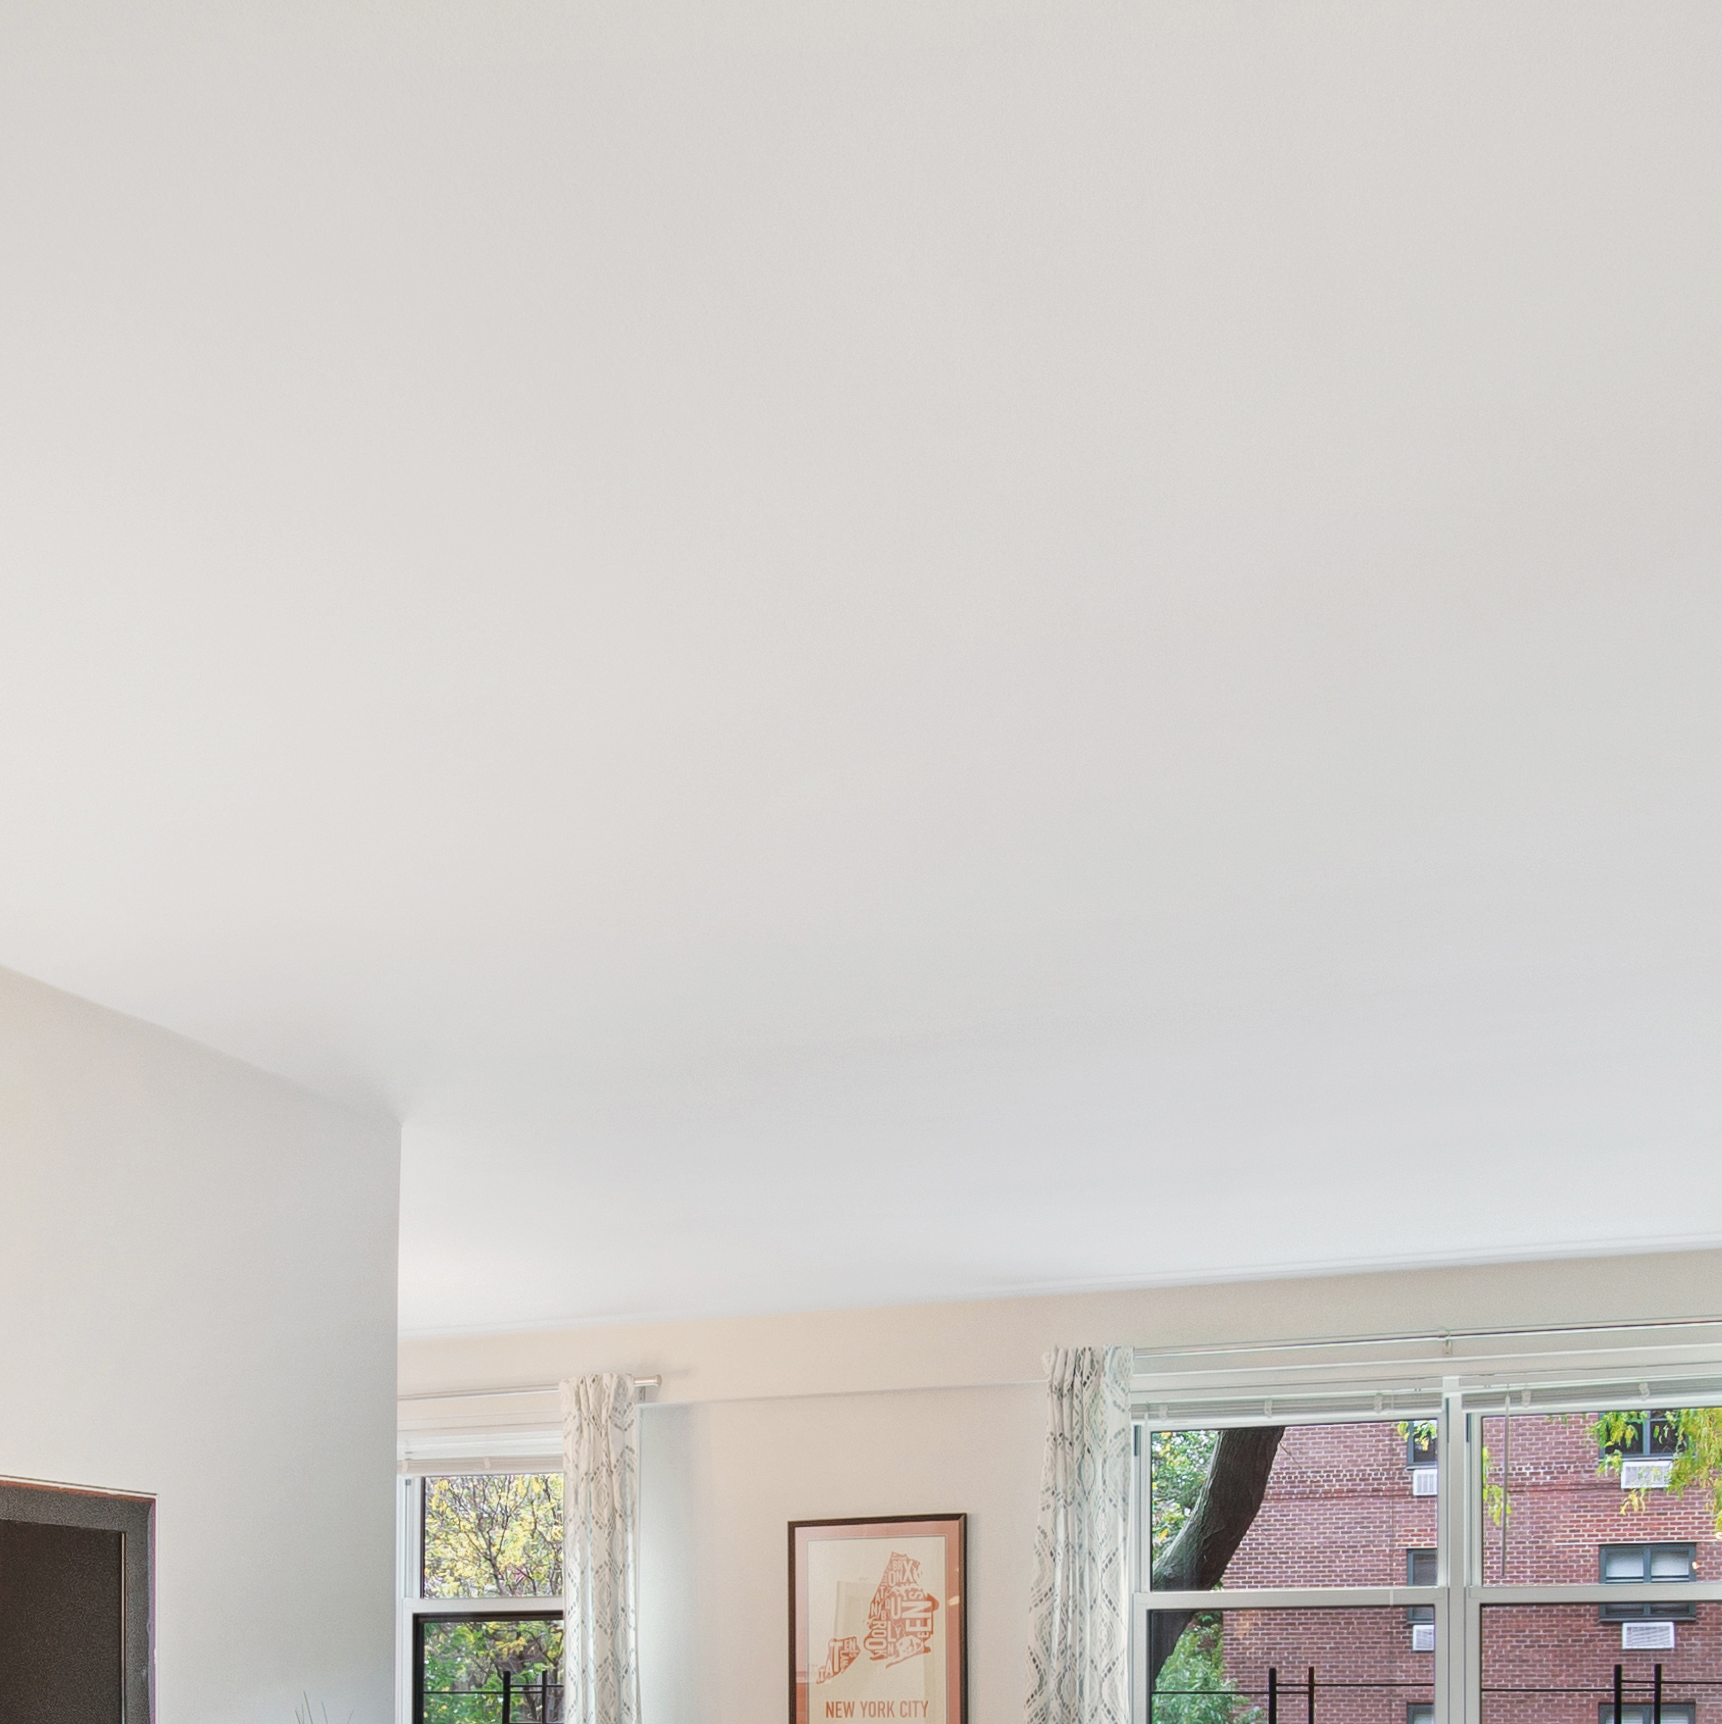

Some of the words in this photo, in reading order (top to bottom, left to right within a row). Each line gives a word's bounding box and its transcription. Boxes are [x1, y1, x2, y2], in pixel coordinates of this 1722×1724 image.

[825, 1701, 855, 1718] NEW
[860, 1701, 895, 1718] YORK
[900, 1700, 929, 1718] CITY
